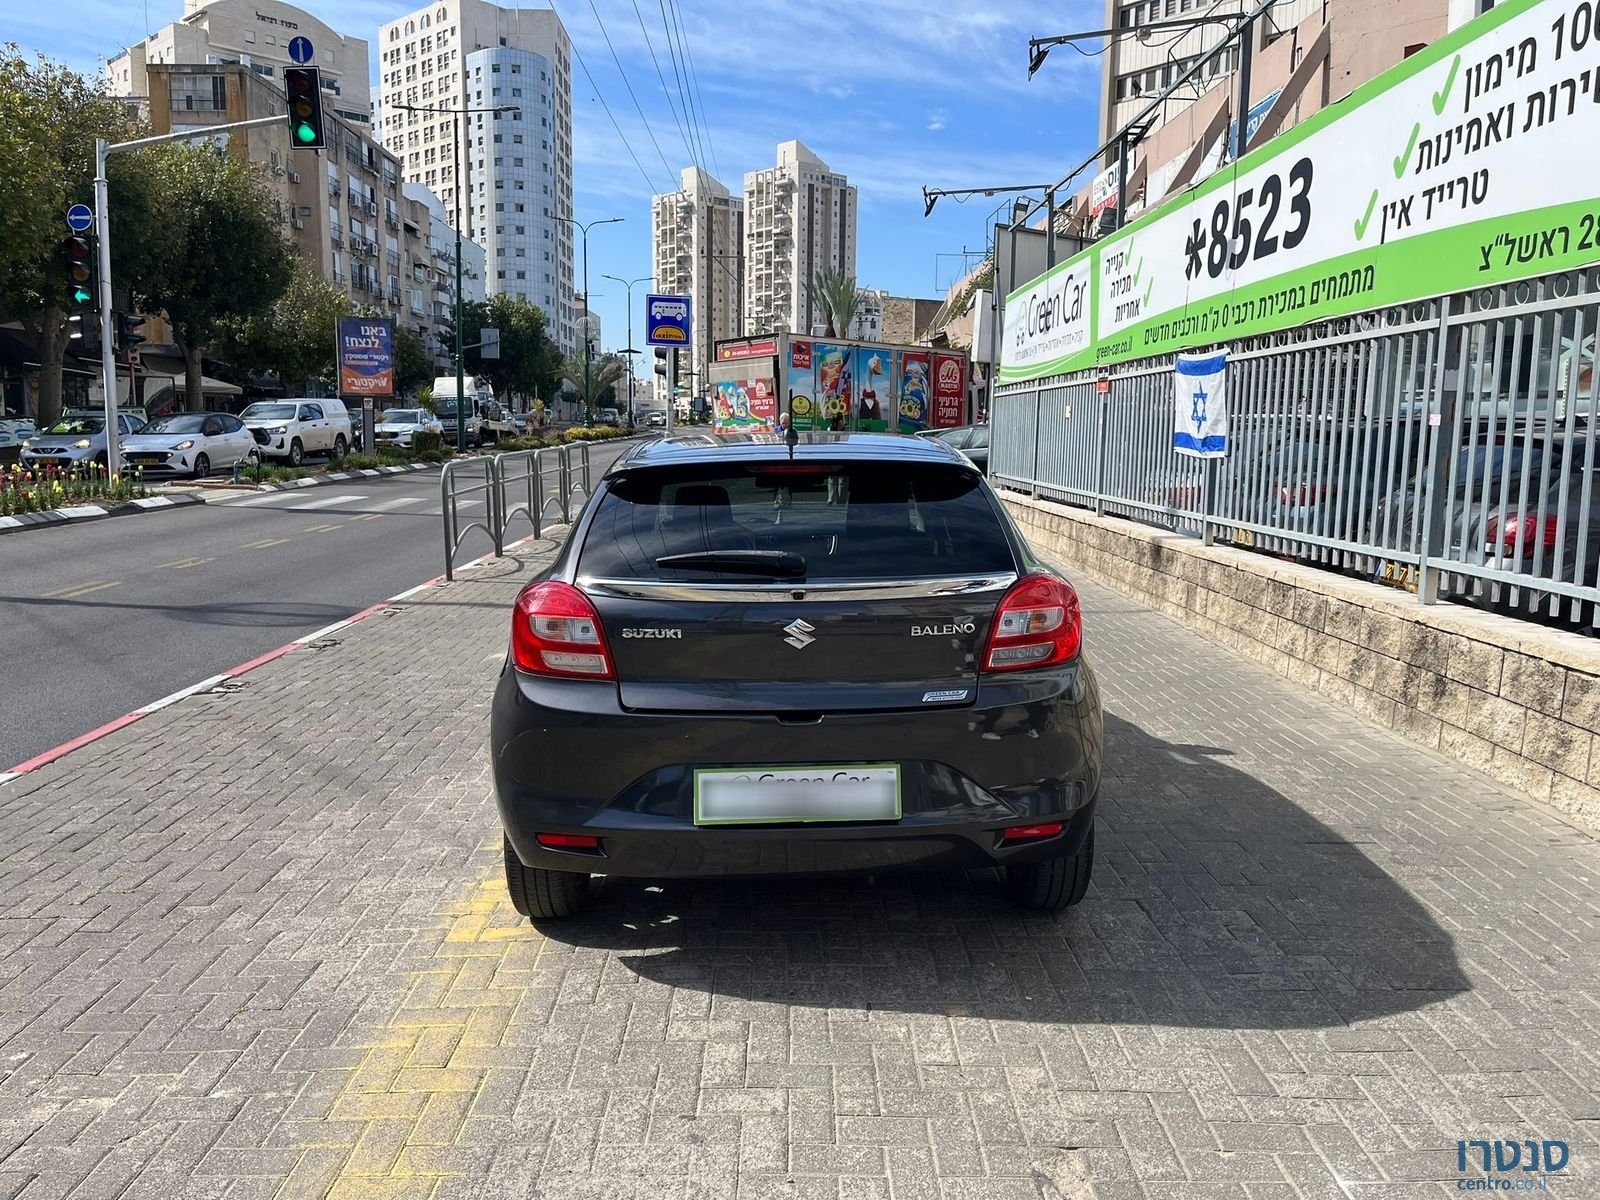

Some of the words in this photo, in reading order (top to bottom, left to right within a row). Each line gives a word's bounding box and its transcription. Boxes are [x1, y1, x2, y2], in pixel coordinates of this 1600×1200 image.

[1463, 36, 1538, 114] מימון
[1522, 65, 1600, 133] ירות
[1414, 102, 1516, 176] ואמינות
[1421, 168, 1490, 220] טרייד
[1380, 194, 1414, 245] אין
[1104, 252, 1125, 276] קנייה
[1110, 274, 1132, 299] מכירה
[1309, 264, 1375, 306] מתמחים
[1028, 293, 1061, 338] Green
[1062, 273, 1088, 325] Car
[1114, 298, 1141, 323] אחריות
[1231, 300, 1255, 325] רכבי
[1257, 285, 1306, 319] במכירת
[1171, 315, 1200, 339] ורכבים
[1222, 303, 1229, 328] 0
[344, 335, 380, 348] לנצח!
[361, 325, 387, 337] באנו
[1144, 323, 1170, 345] חדשים
[1096, 335, 1134, 362] green-car.co.il
[621, 628, 682, 639] SUZUKI
[911, 622, 976, 637] BALENO
